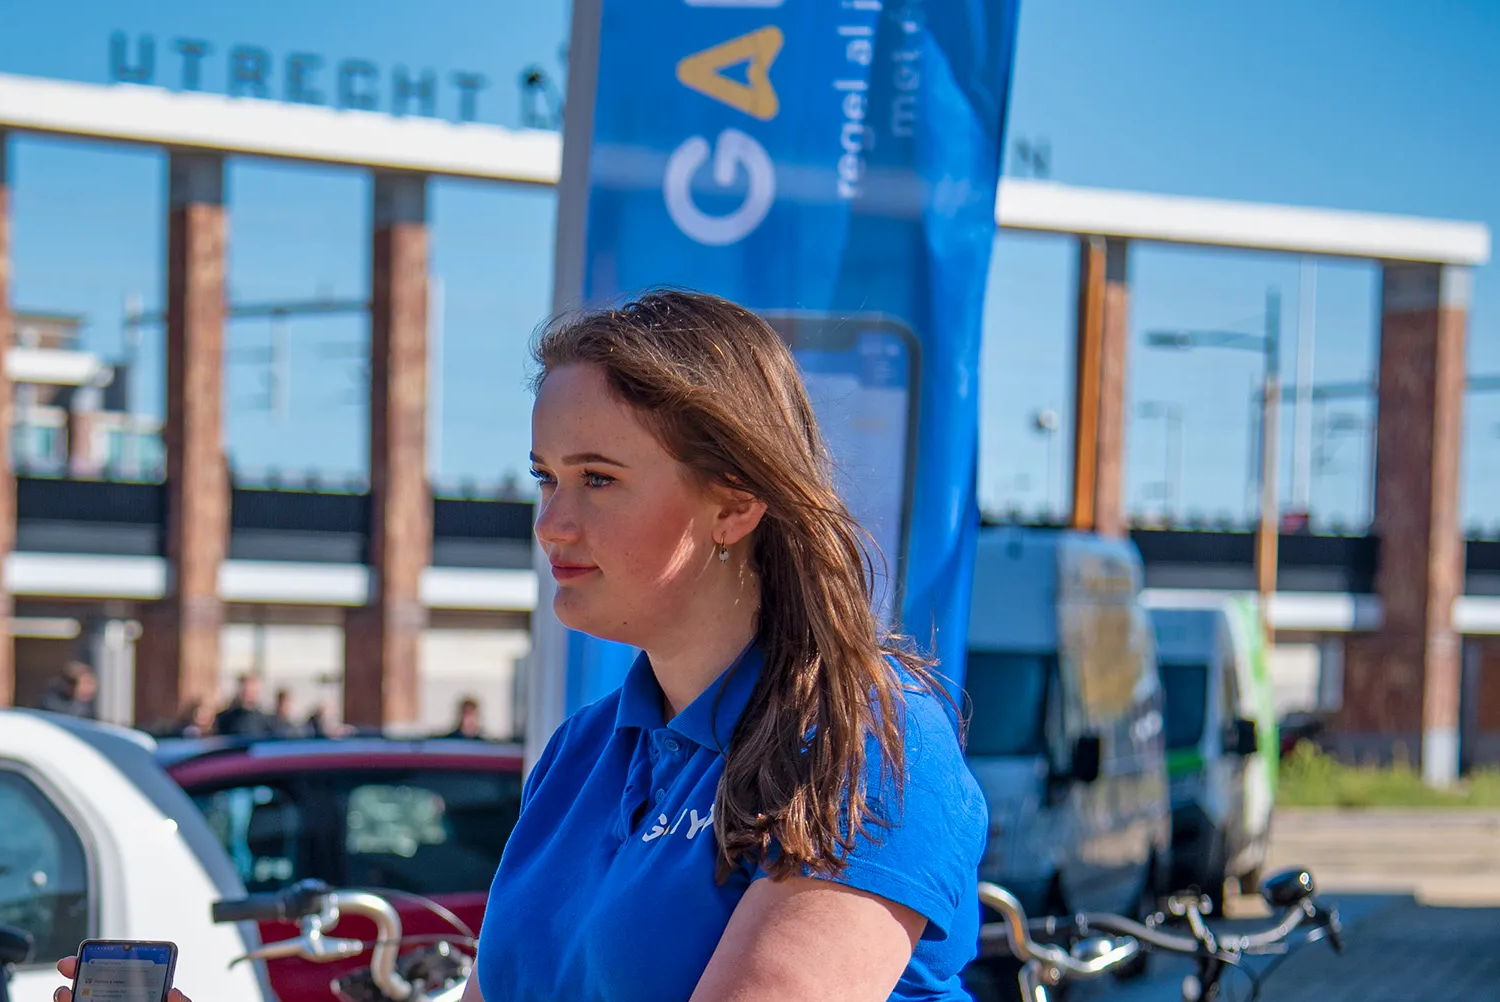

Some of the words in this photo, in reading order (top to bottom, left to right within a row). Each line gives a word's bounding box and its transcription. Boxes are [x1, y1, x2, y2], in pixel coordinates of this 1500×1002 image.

[109, 31, 491, 124] UTRECHT
[838, 25, 873, 66] al
[662, 0, 786, 247] GA
[833, 79, 876, 199] regel
